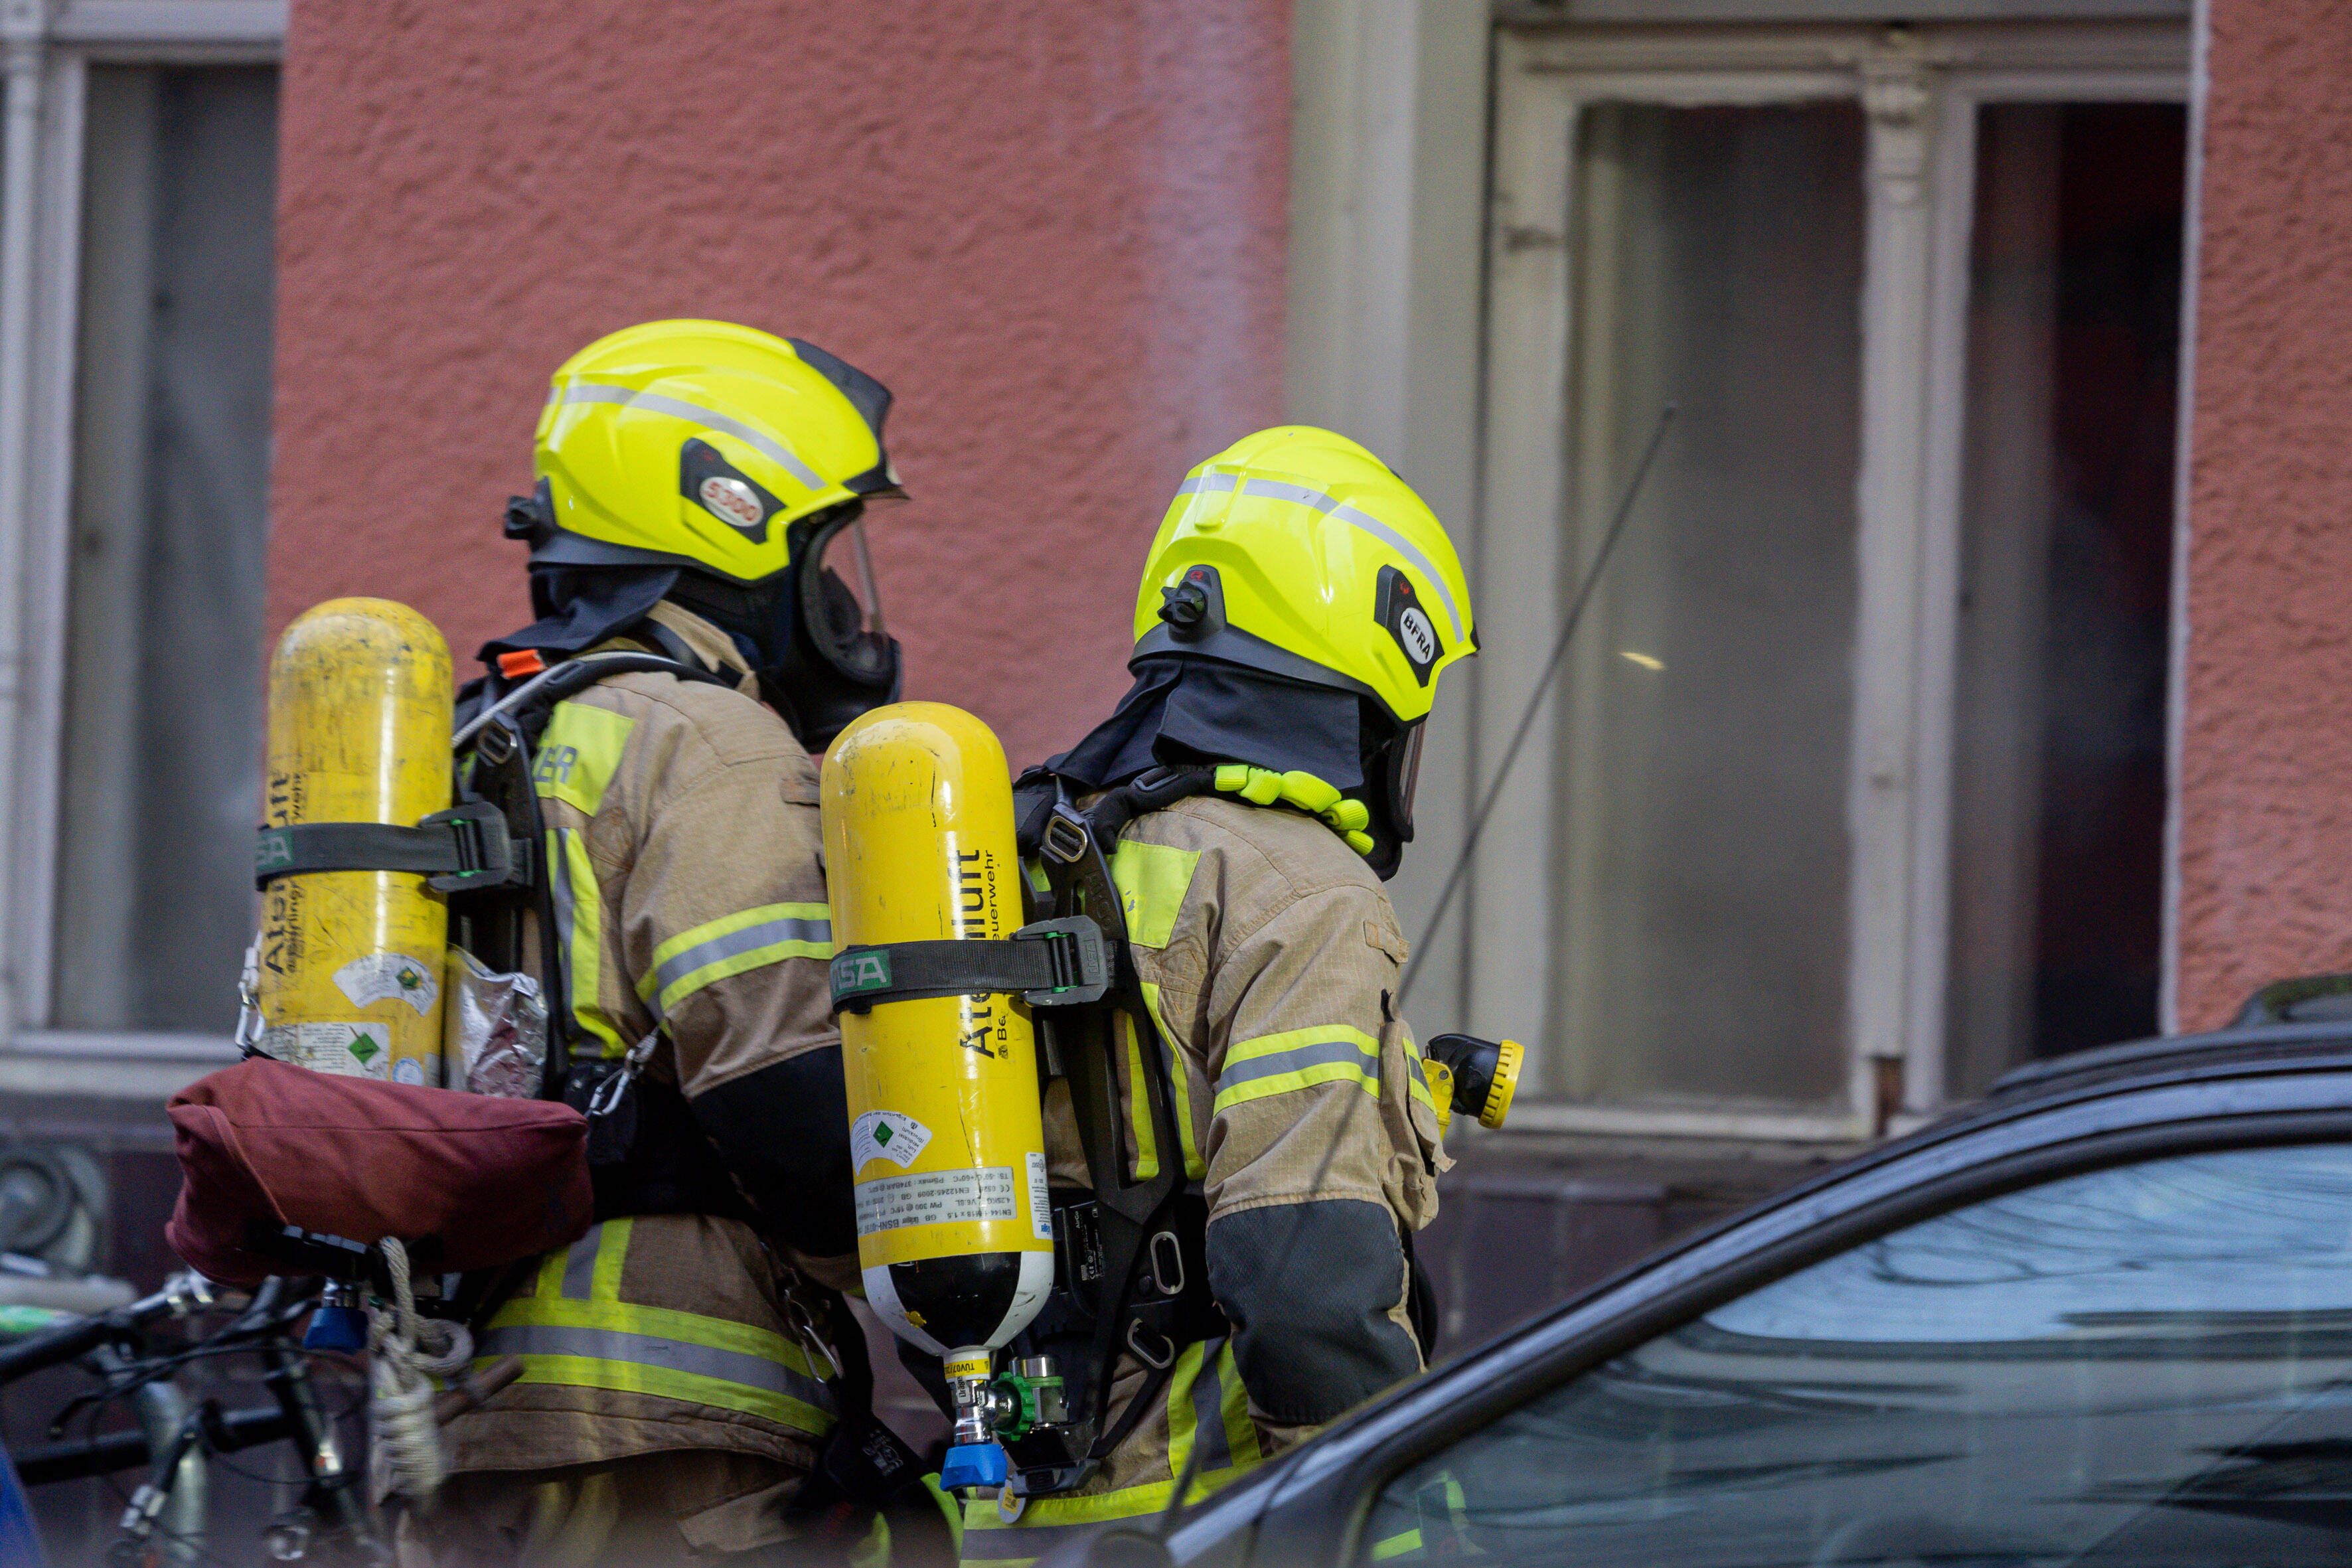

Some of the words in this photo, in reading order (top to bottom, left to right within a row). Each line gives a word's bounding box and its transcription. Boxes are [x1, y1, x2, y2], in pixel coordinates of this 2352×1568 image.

[1403, 612, 1431, 661] BFRA
[984, 850, 1000, 941] euerwehr
[947, 850, 994, 1059] Ateluft
[956, 1376, 967, 1398] Dräge
